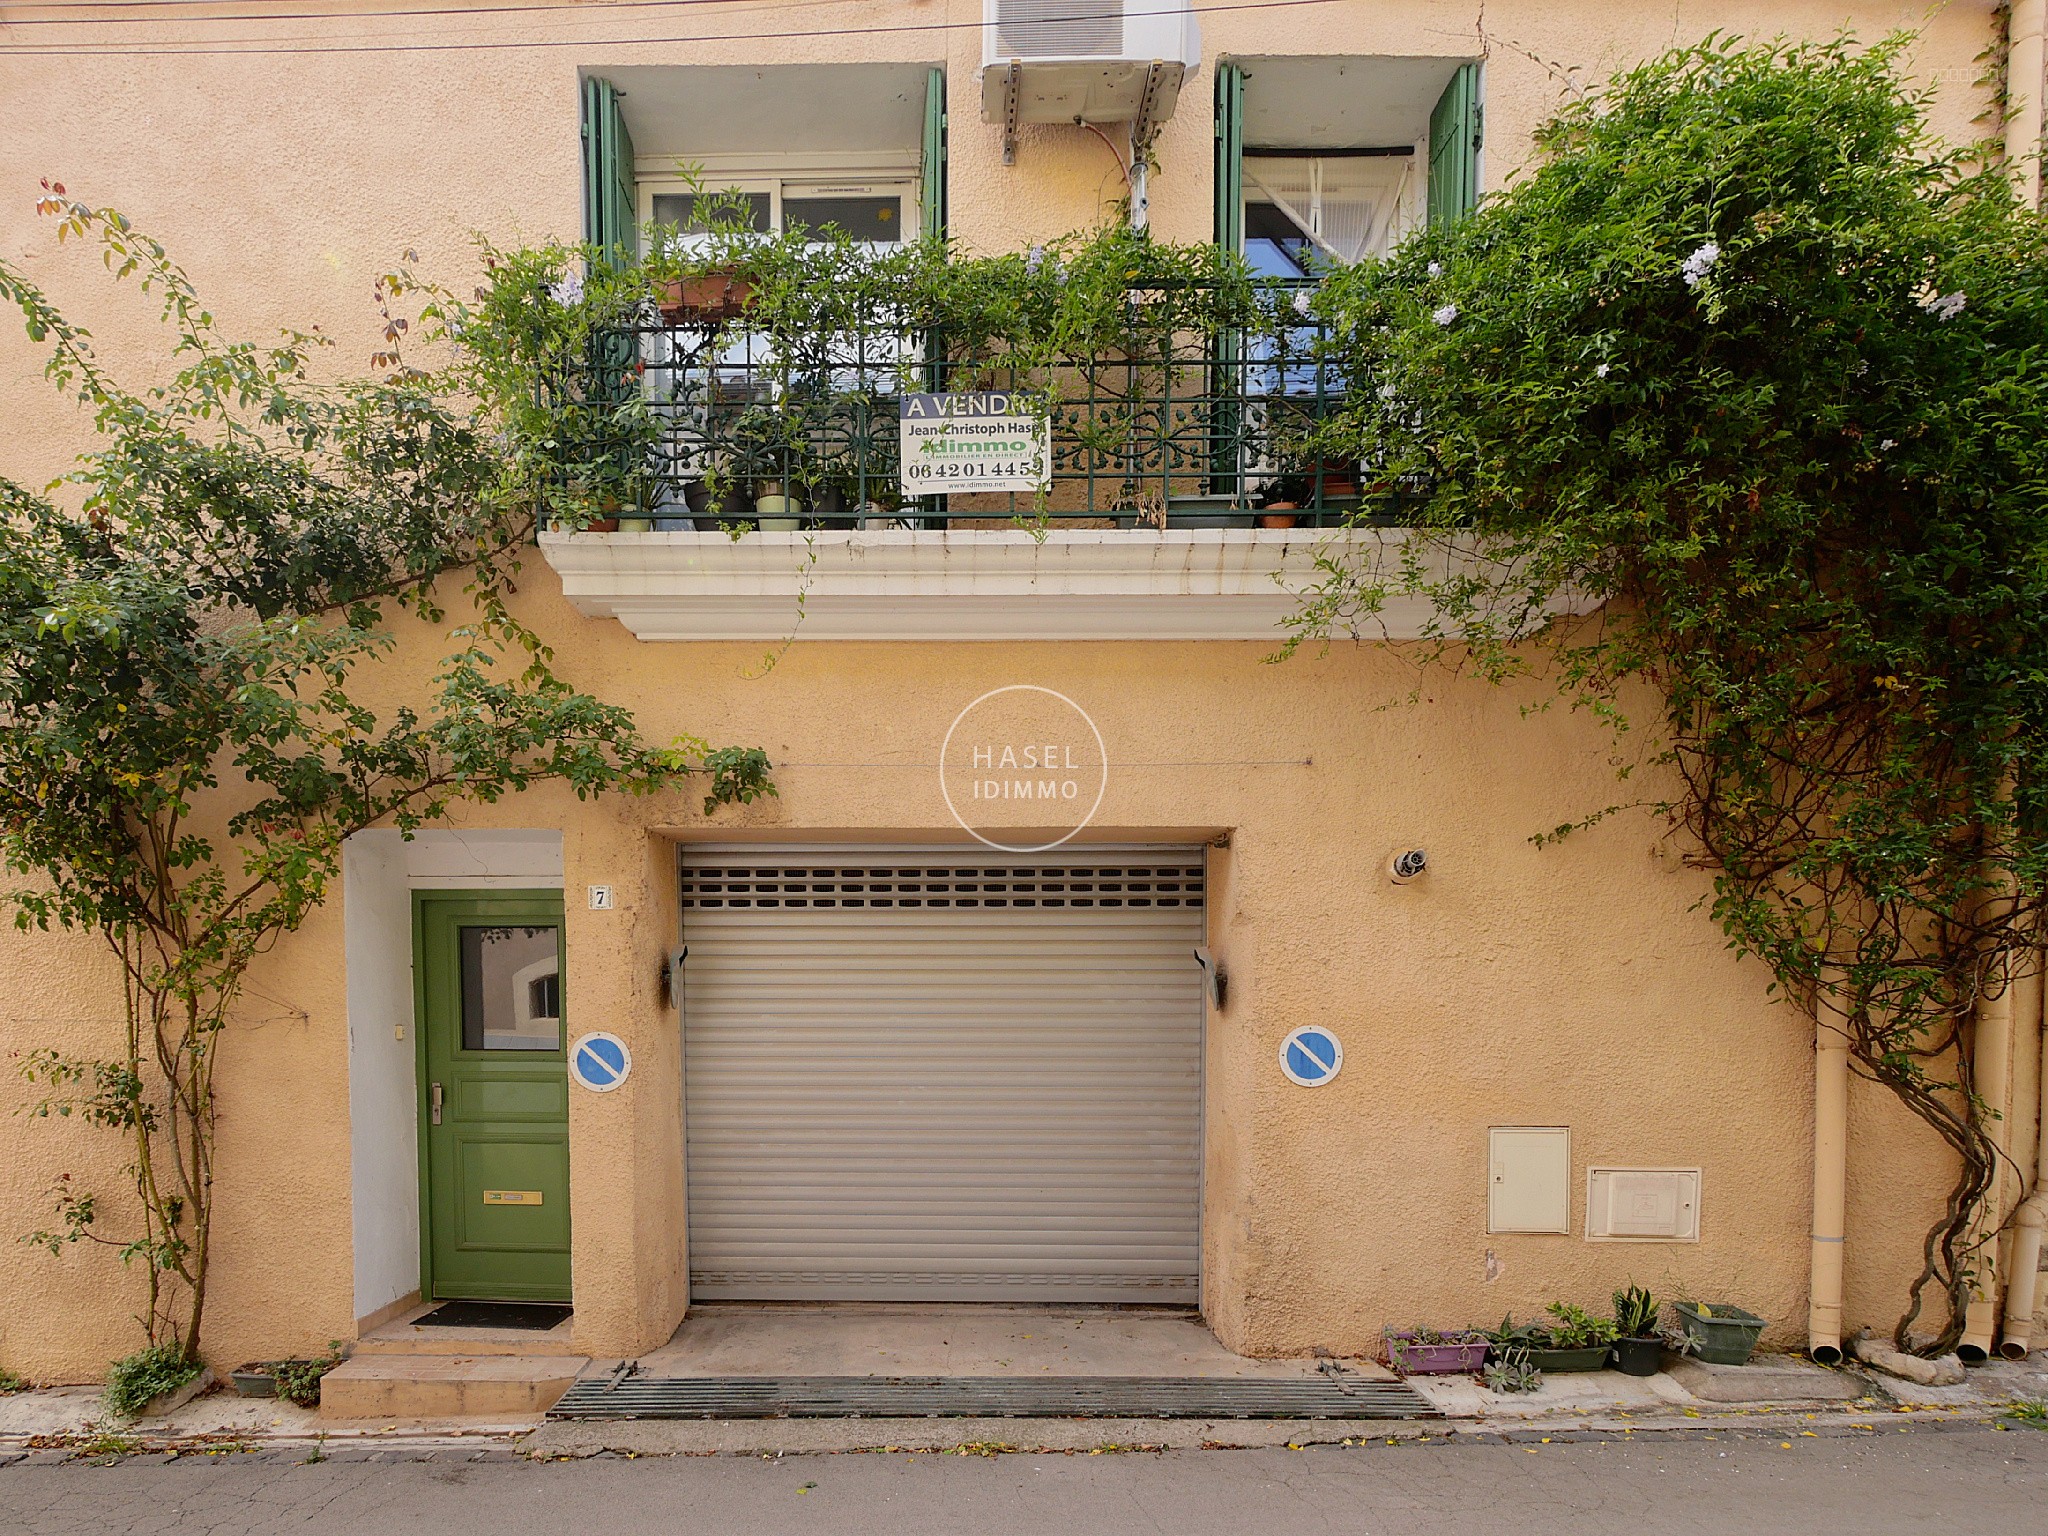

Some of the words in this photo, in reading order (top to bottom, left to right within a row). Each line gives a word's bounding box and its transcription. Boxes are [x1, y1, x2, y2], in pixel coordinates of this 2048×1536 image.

[907, 398, 926, 416] A
[932, 394, 1042, 416] VEND
[596, 891, 605, 905] 7
